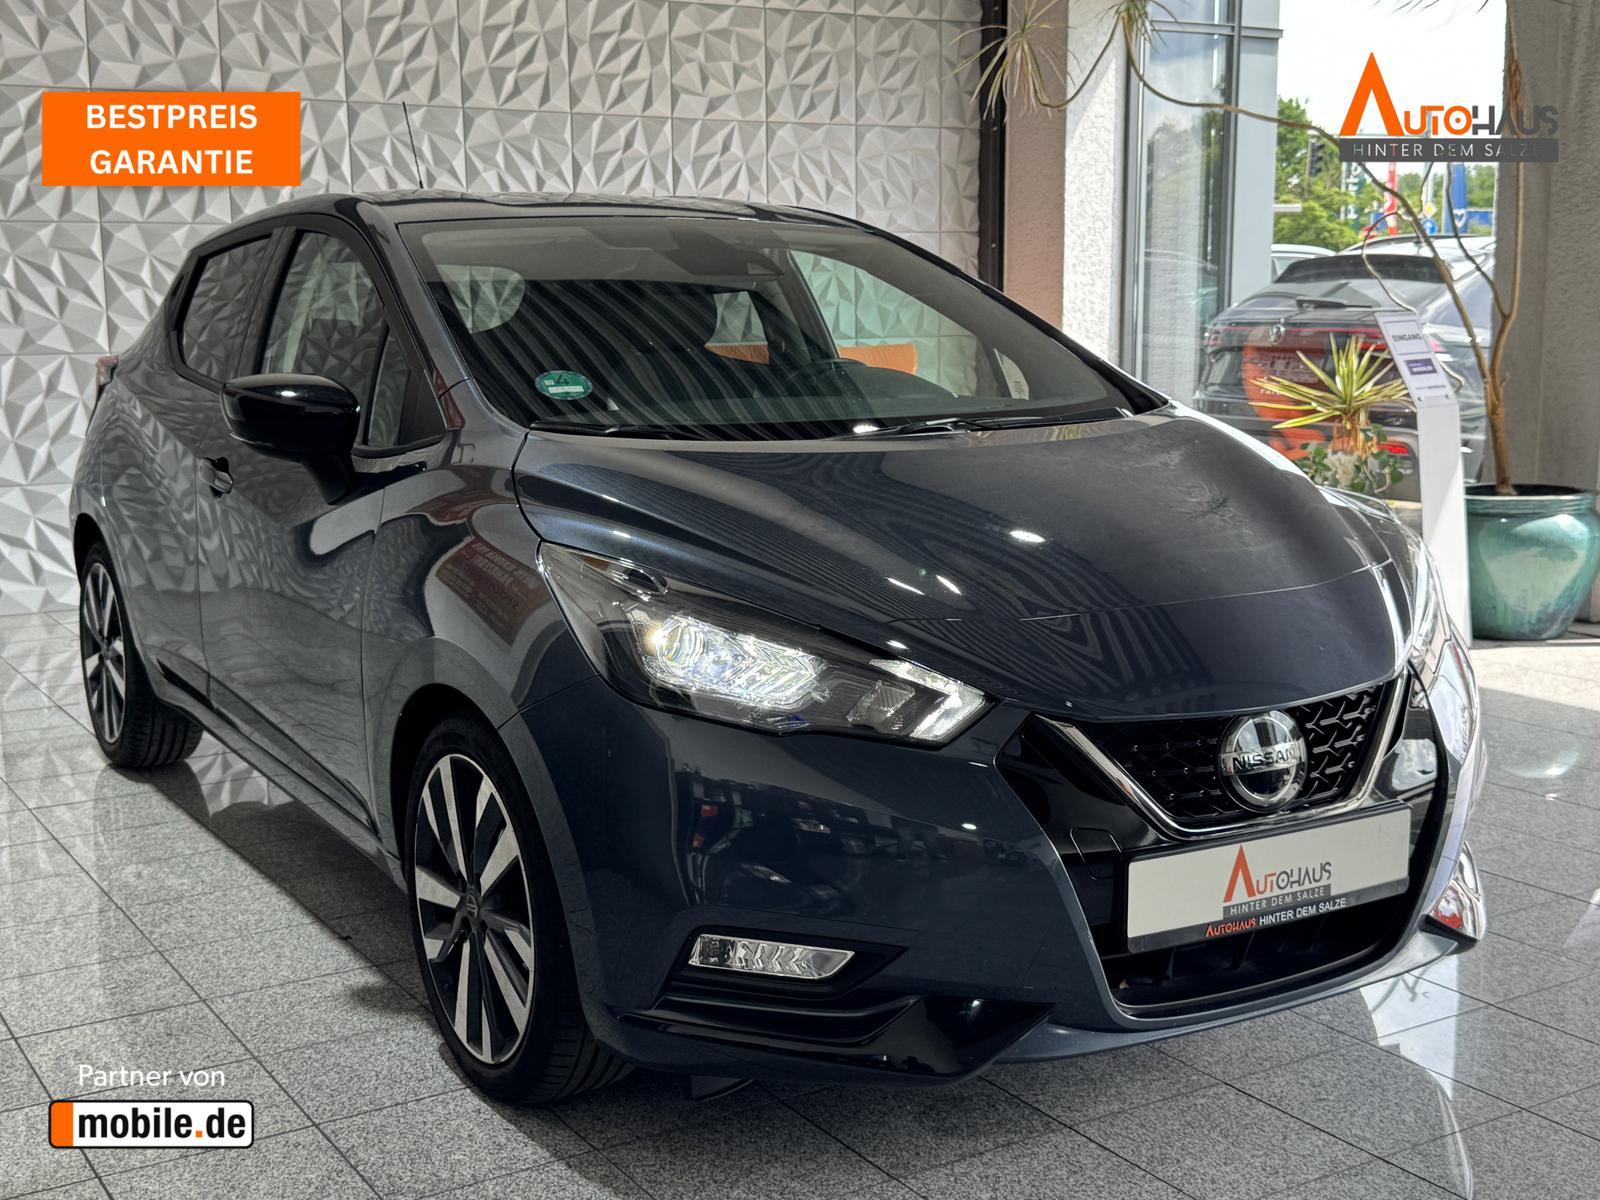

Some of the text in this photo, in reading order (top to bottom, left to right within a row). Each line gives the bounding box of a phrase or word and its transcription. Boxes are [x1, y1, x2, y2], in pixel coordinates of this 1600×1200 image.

[1231, 746, 1297, 771] NISSAN
[1223, 845, 1332, 903] AUTOHAUS
[1205, 897, 1346, 937] AUTOHAUS HINTER DEM SALZE
[1230, 888, 1325, 915] HINTER DEM SALZE
